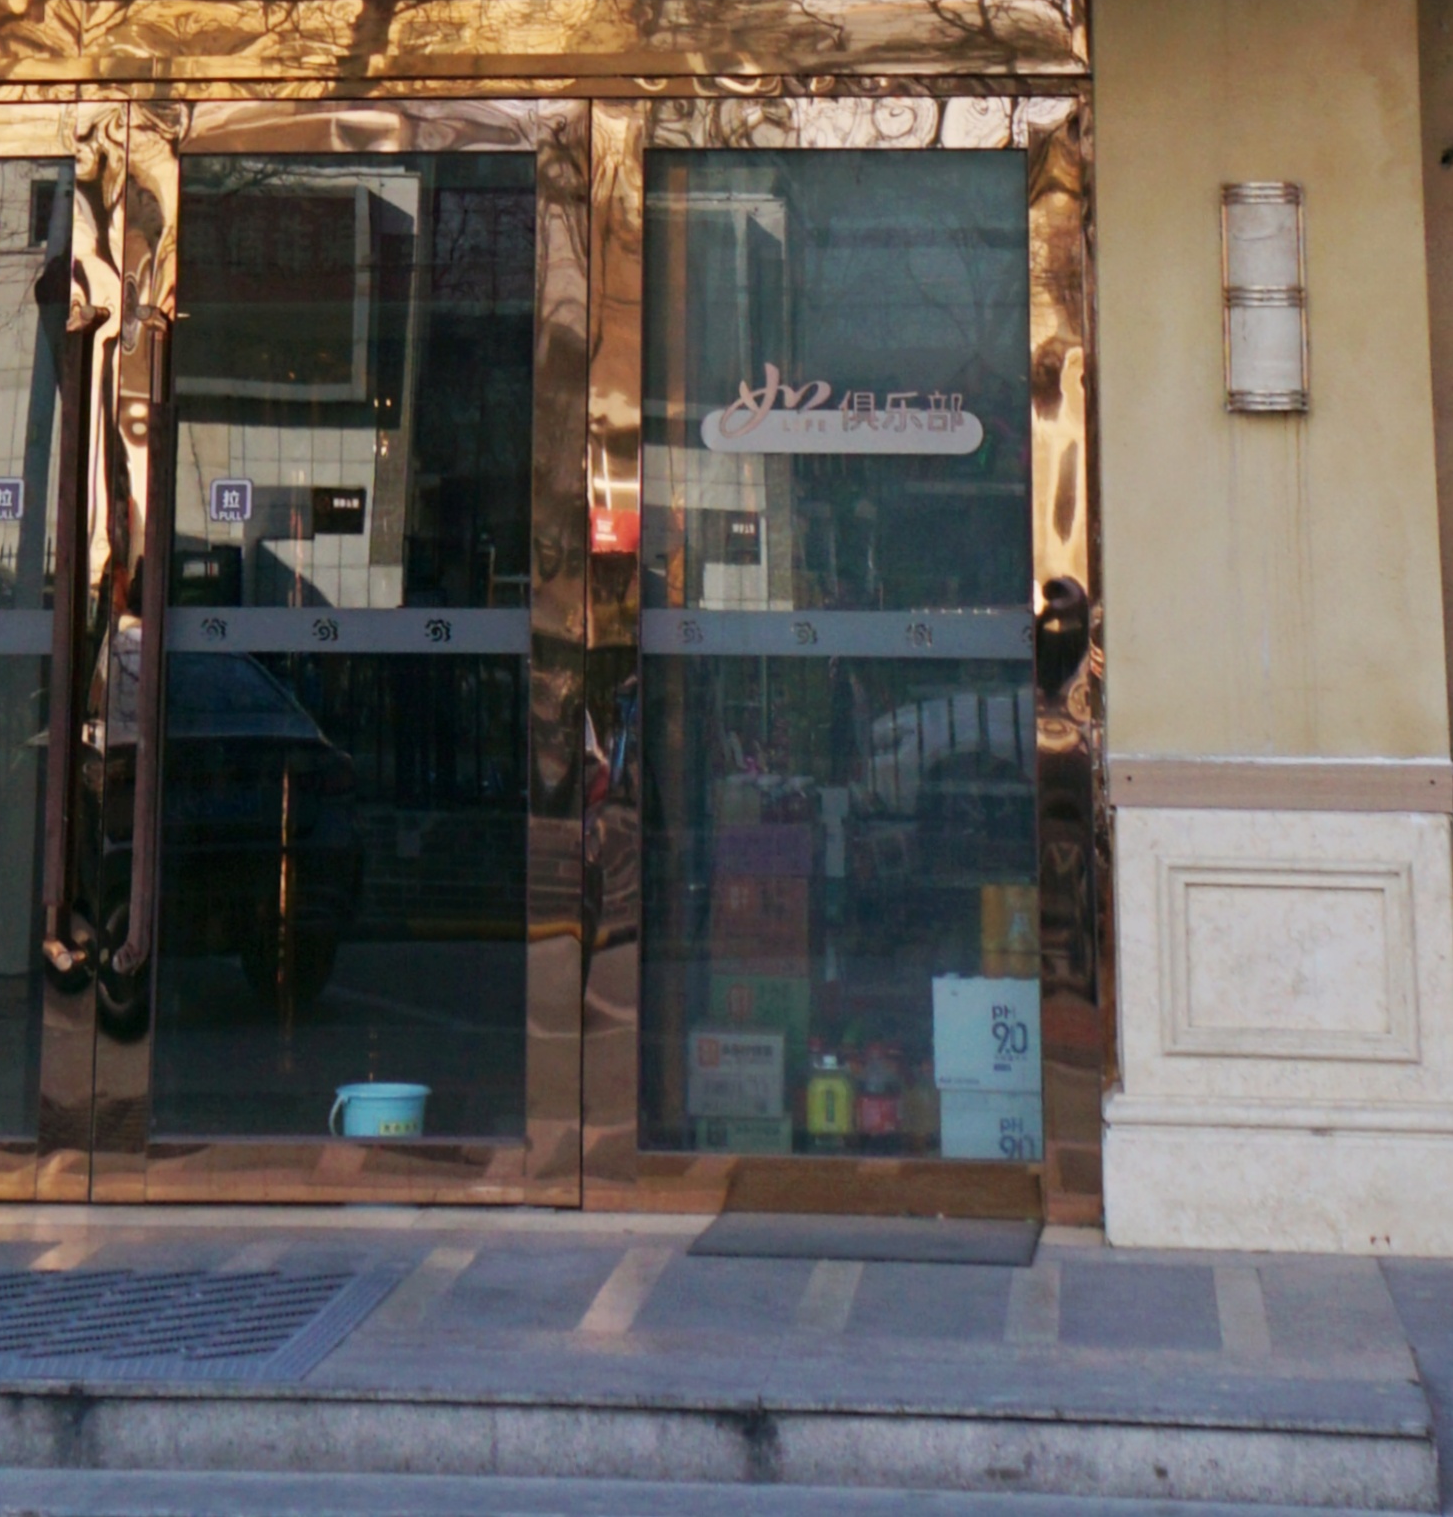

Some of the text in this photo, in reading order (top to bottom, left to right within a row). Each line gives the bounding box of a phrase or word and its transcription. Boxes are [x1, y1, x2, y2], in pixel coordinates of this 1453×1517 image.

[838, 389, 965, 434] 俱乐部
[222, 489, 240, 509] 拉
[218, 511, 243, 521] PULL
[991, 1021, 1029, 1055] 9.0
